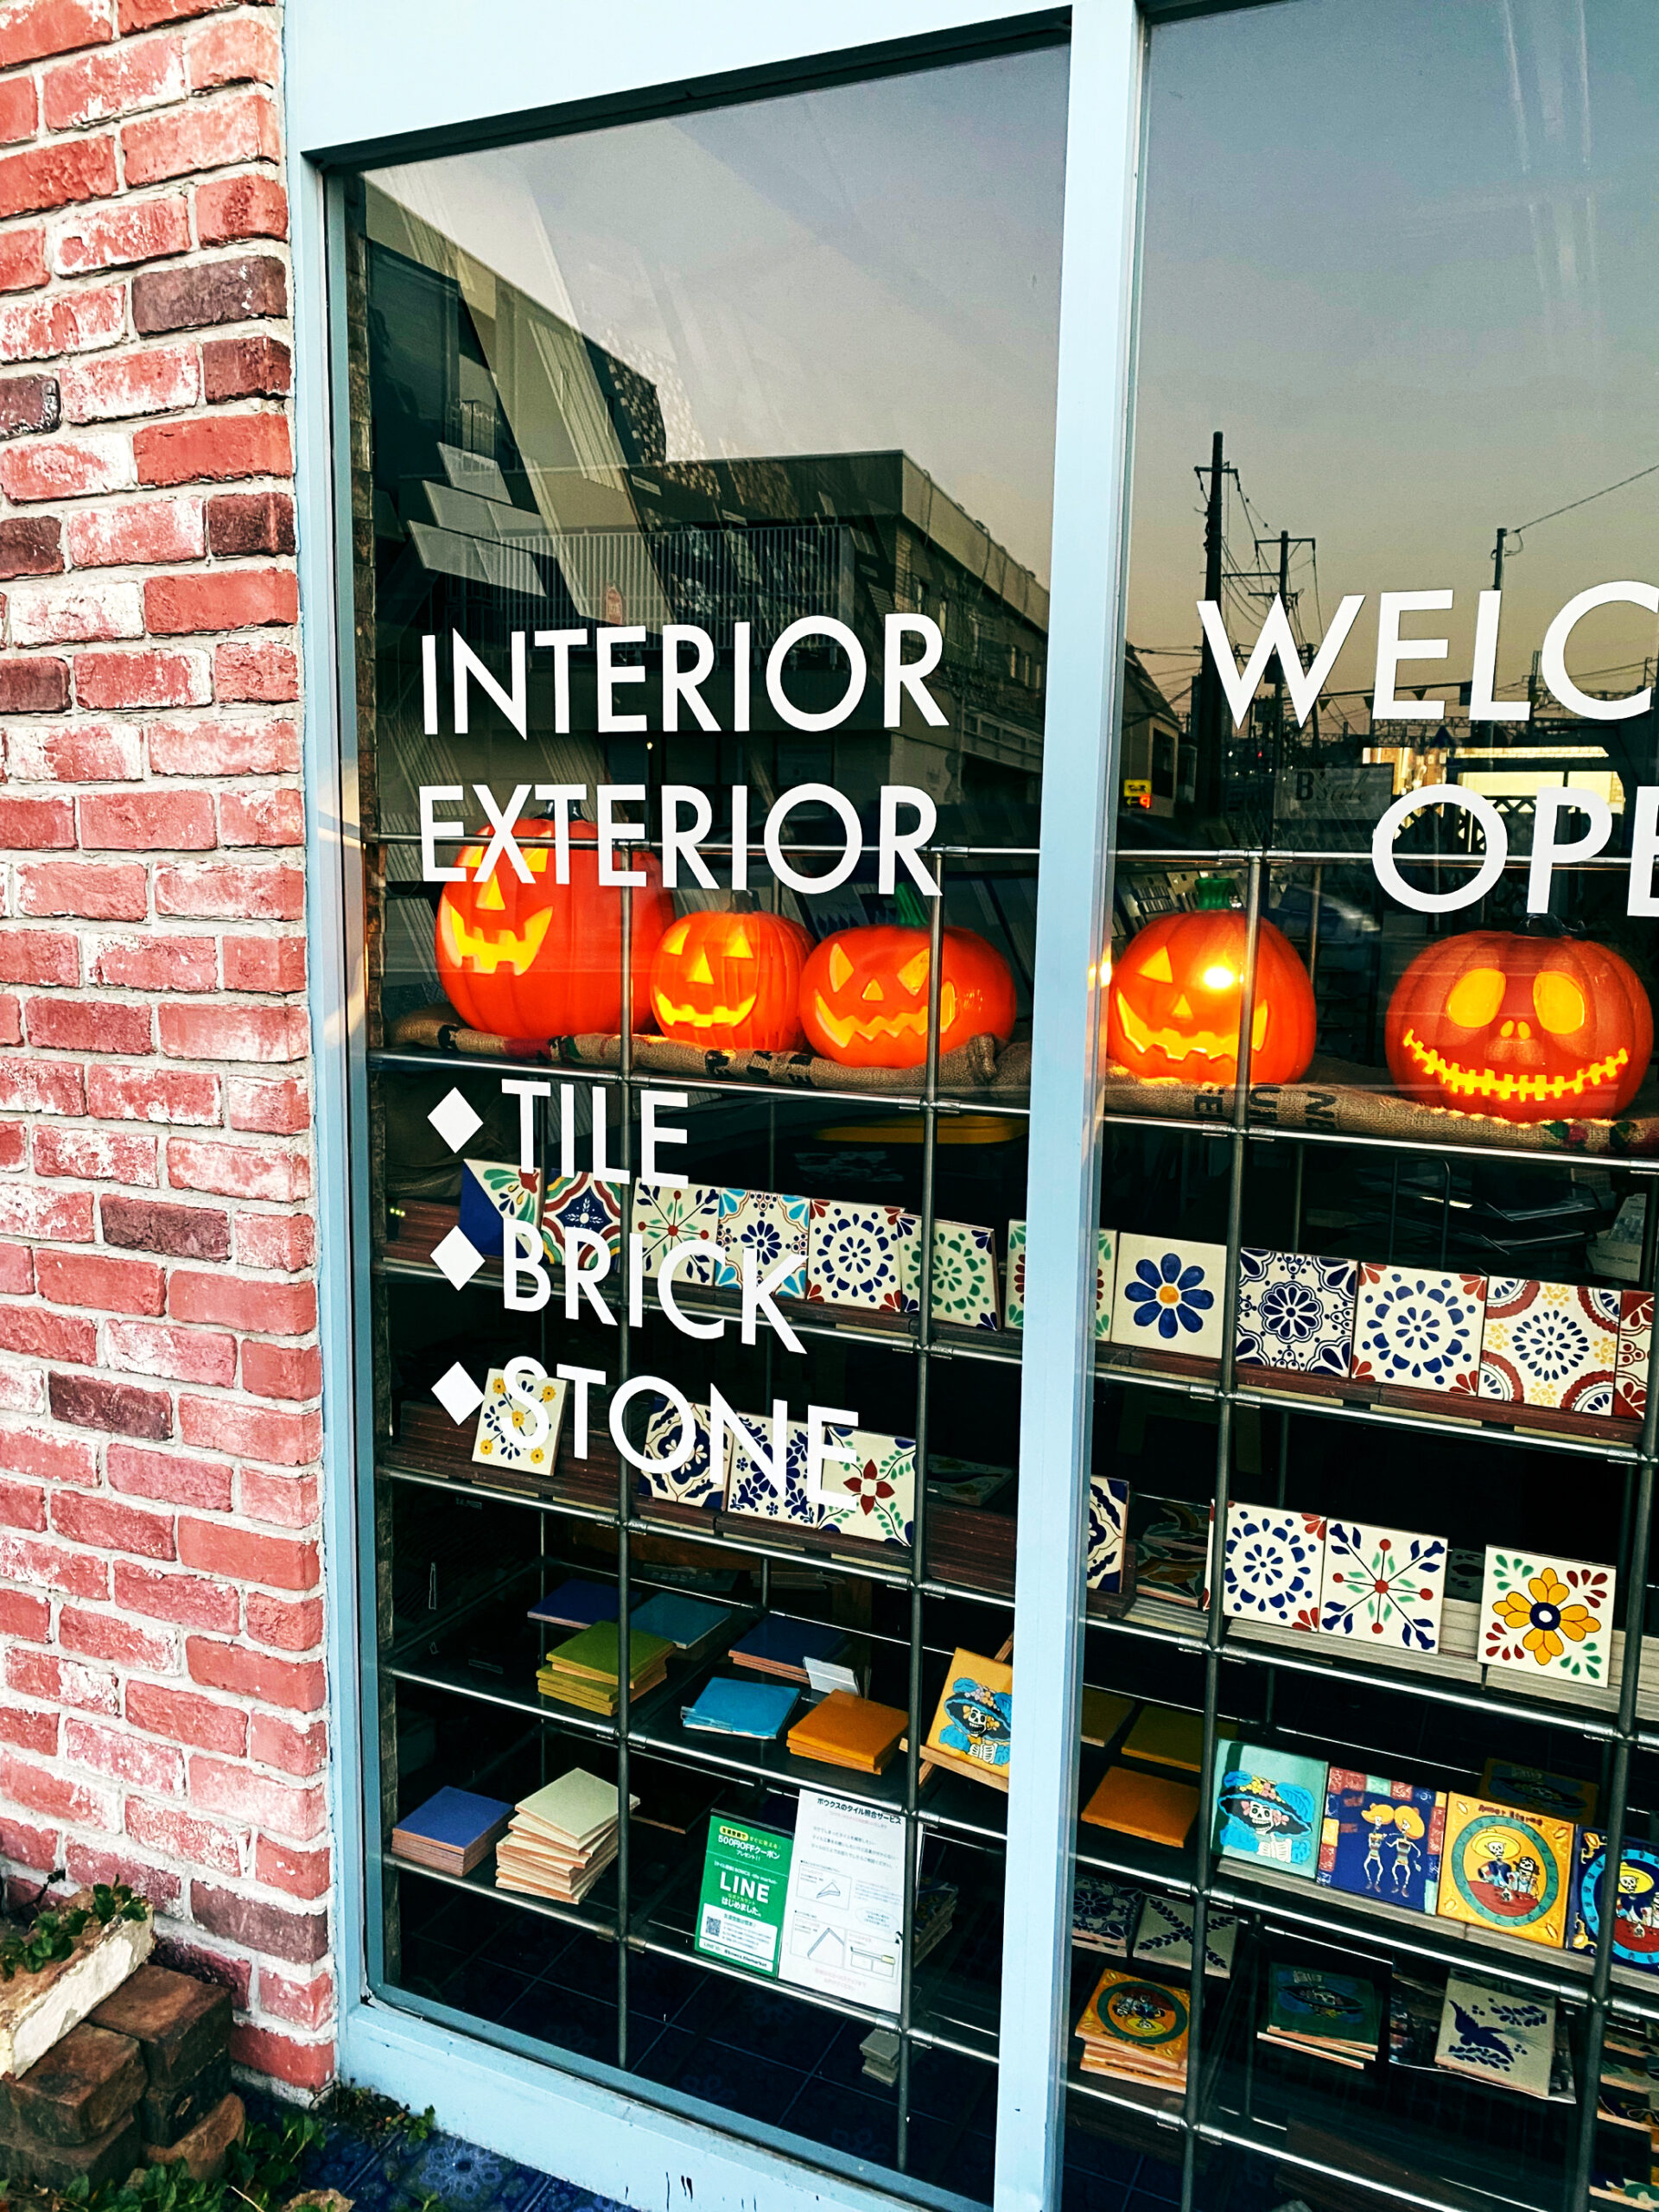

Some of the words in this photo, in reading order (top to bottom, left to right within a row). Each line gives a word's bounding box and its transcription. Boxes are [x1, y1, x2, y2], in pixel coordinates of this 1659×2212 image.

[422, 613, 950, 740] INTERIOR
[1196, 581, 1659, 730] WELC
[419, 783, 943, 897] EXTERIOR
[501, 1079, 690, 1190] TILE
[502, 1217, 809, 1355] BRICK
[499, 1356, 859, 1511] STONE
[720, 1871, 770, 1904] LINE
[721, 1897, 762, 1917] はじめました。
